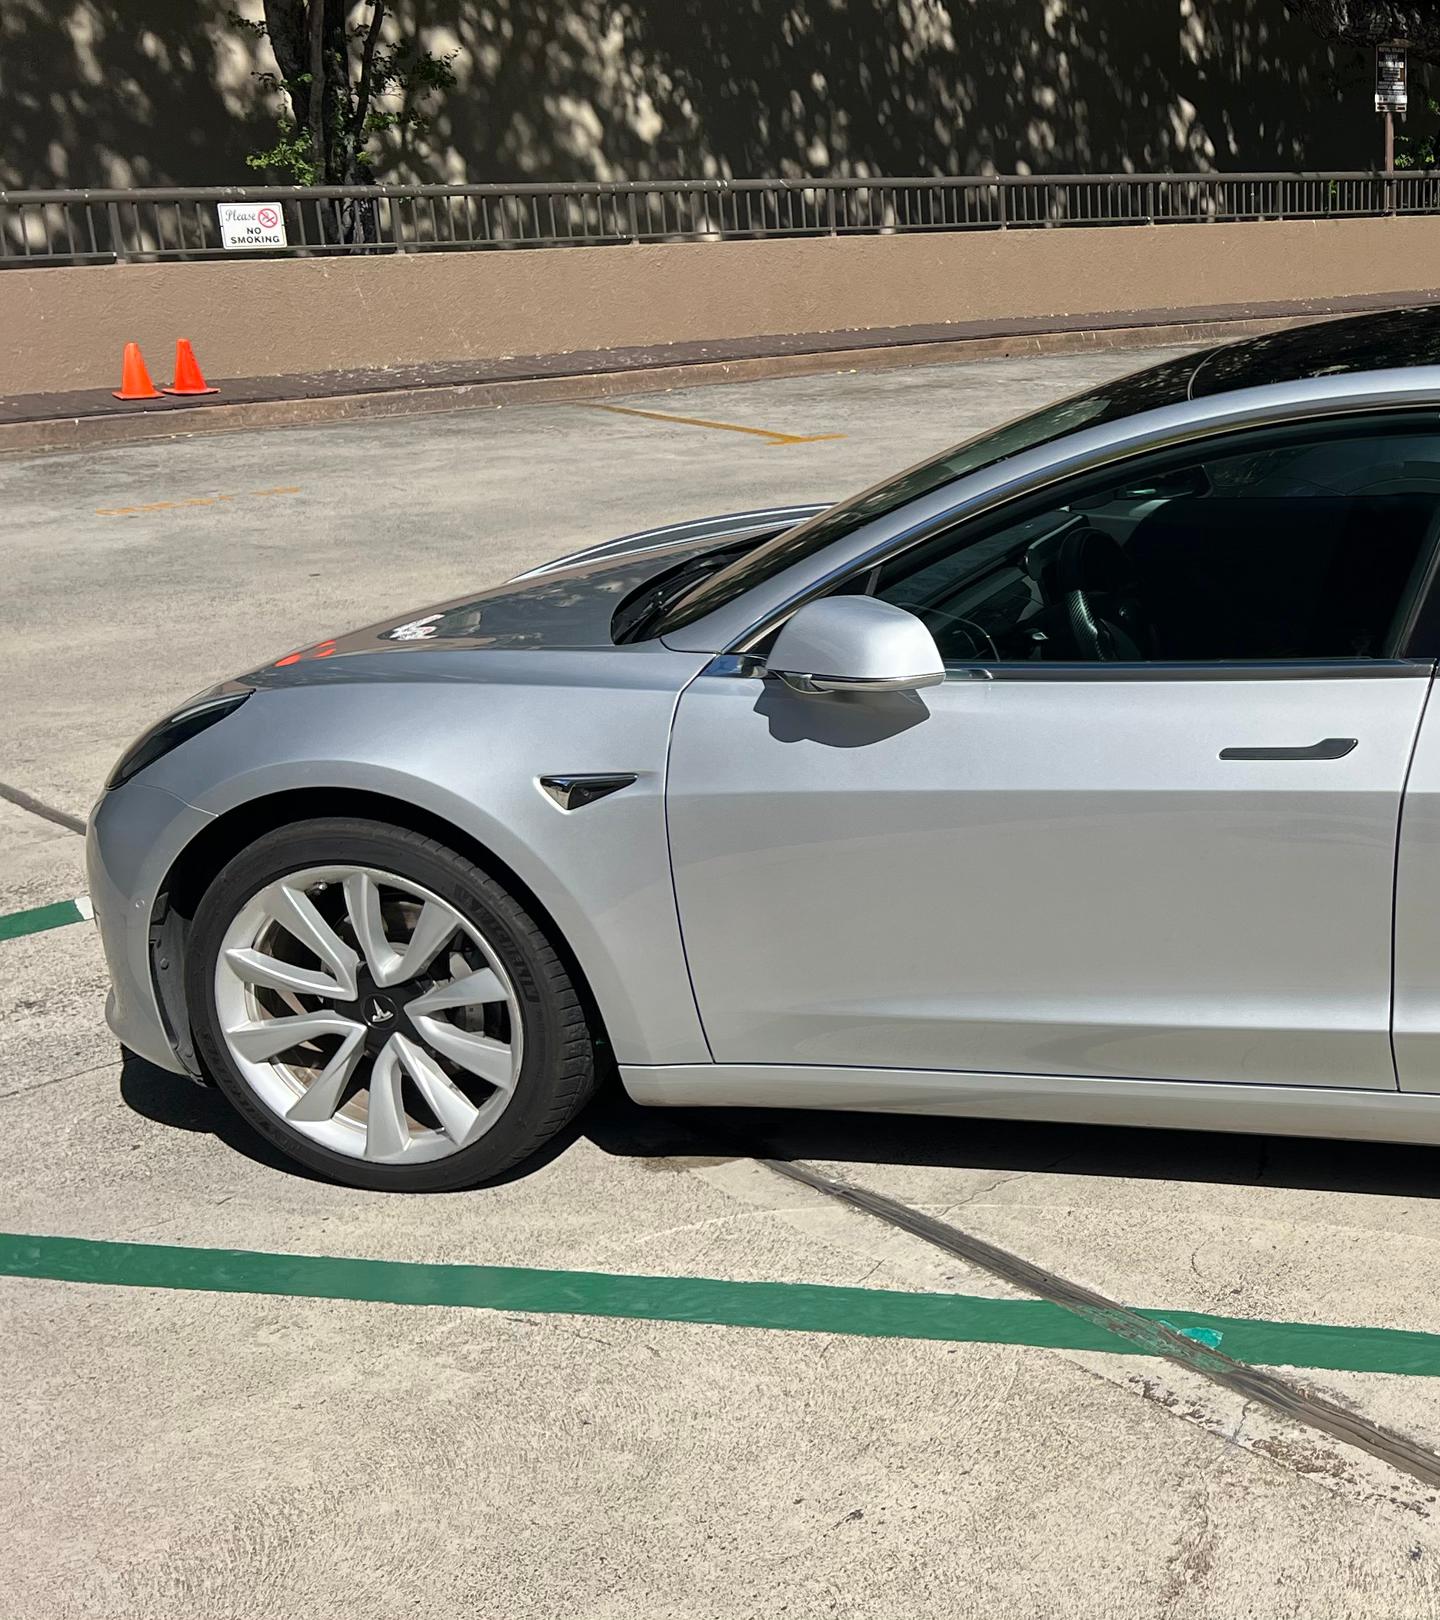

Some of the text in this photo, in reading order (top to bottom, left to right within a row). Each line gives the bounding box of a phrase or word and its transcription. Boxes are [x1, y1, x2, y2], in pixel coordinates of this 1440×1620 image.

[225, 208, 256, 222] Please
[246, 227, 262, 235] NO
[230, 235, 280, 244] SMOKING
